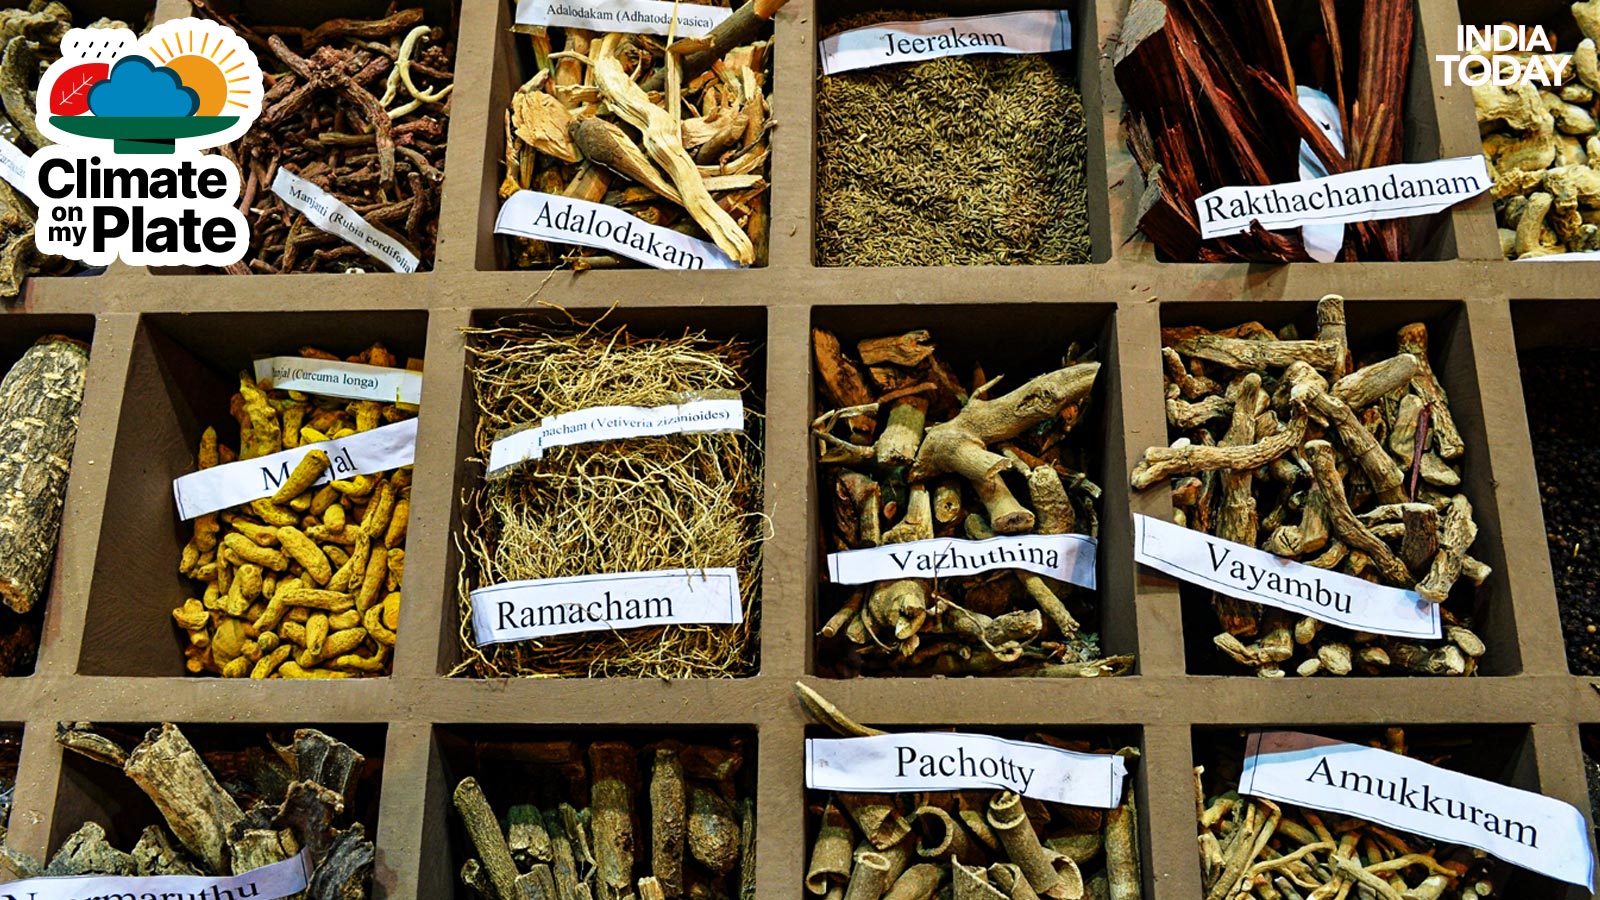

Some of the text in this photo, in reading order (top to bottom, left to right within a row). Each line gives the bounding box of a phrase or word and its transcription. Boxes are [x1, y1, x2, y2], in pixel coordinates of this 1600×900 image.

[546, 4, 714, 30] Adalodakam (Adhatoda vasica)
[885, 27, 1007, 57] Jeerakam
[289, 185, 329, 217] Manjatti
[329, 211, 365, 239] (Rubia
[1205, 173, 1481, 224] Rakthachandanam
[532, 200, 705, 270] Adalodakam
[292, 368, 340, 384] (Curcuma
[342, 373, 379, 390] longa)
[590, 416, 653, 431] (Vetiveria
[656, 409, 730, 427] zizanioides)
[259, 446, 359, 491] Mjal
[889, 542, 1060, 572] Vazhuthina
[1205, 541, 1353, 614] Vayambu
[495, 590, 674, 631] Ramacham
[894, 745, 1035, 794] Pachotty
[1305, 756, 1539, 850] Amukkuram
